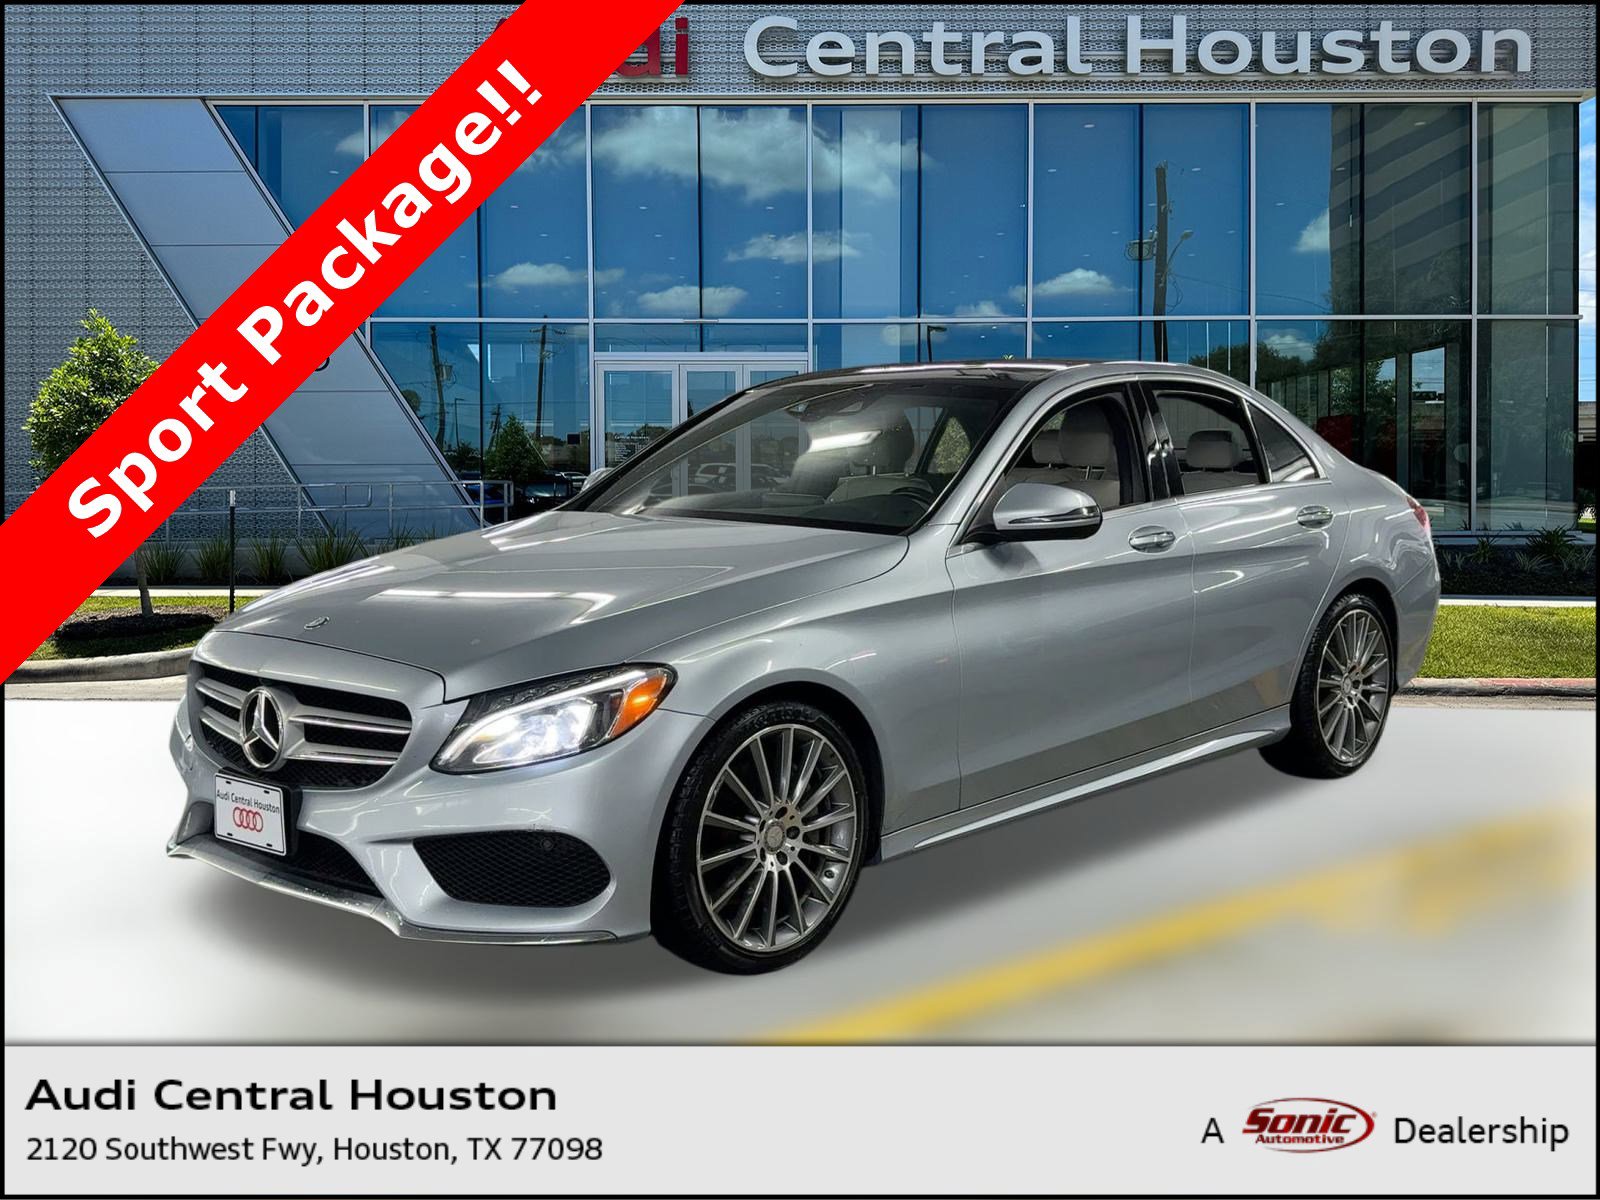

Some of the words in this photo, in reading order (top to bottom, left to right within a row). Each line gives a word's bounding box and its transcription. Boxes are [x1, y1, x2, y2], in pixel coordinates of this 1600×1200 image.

[743, 16, 1093, 77] Central
[1127, 15, 1532, 75] Houston
[216, 789, 229, 801] Audi
[231, 792, 253, 807] Central
[253, 799, 280, 815] Houston
